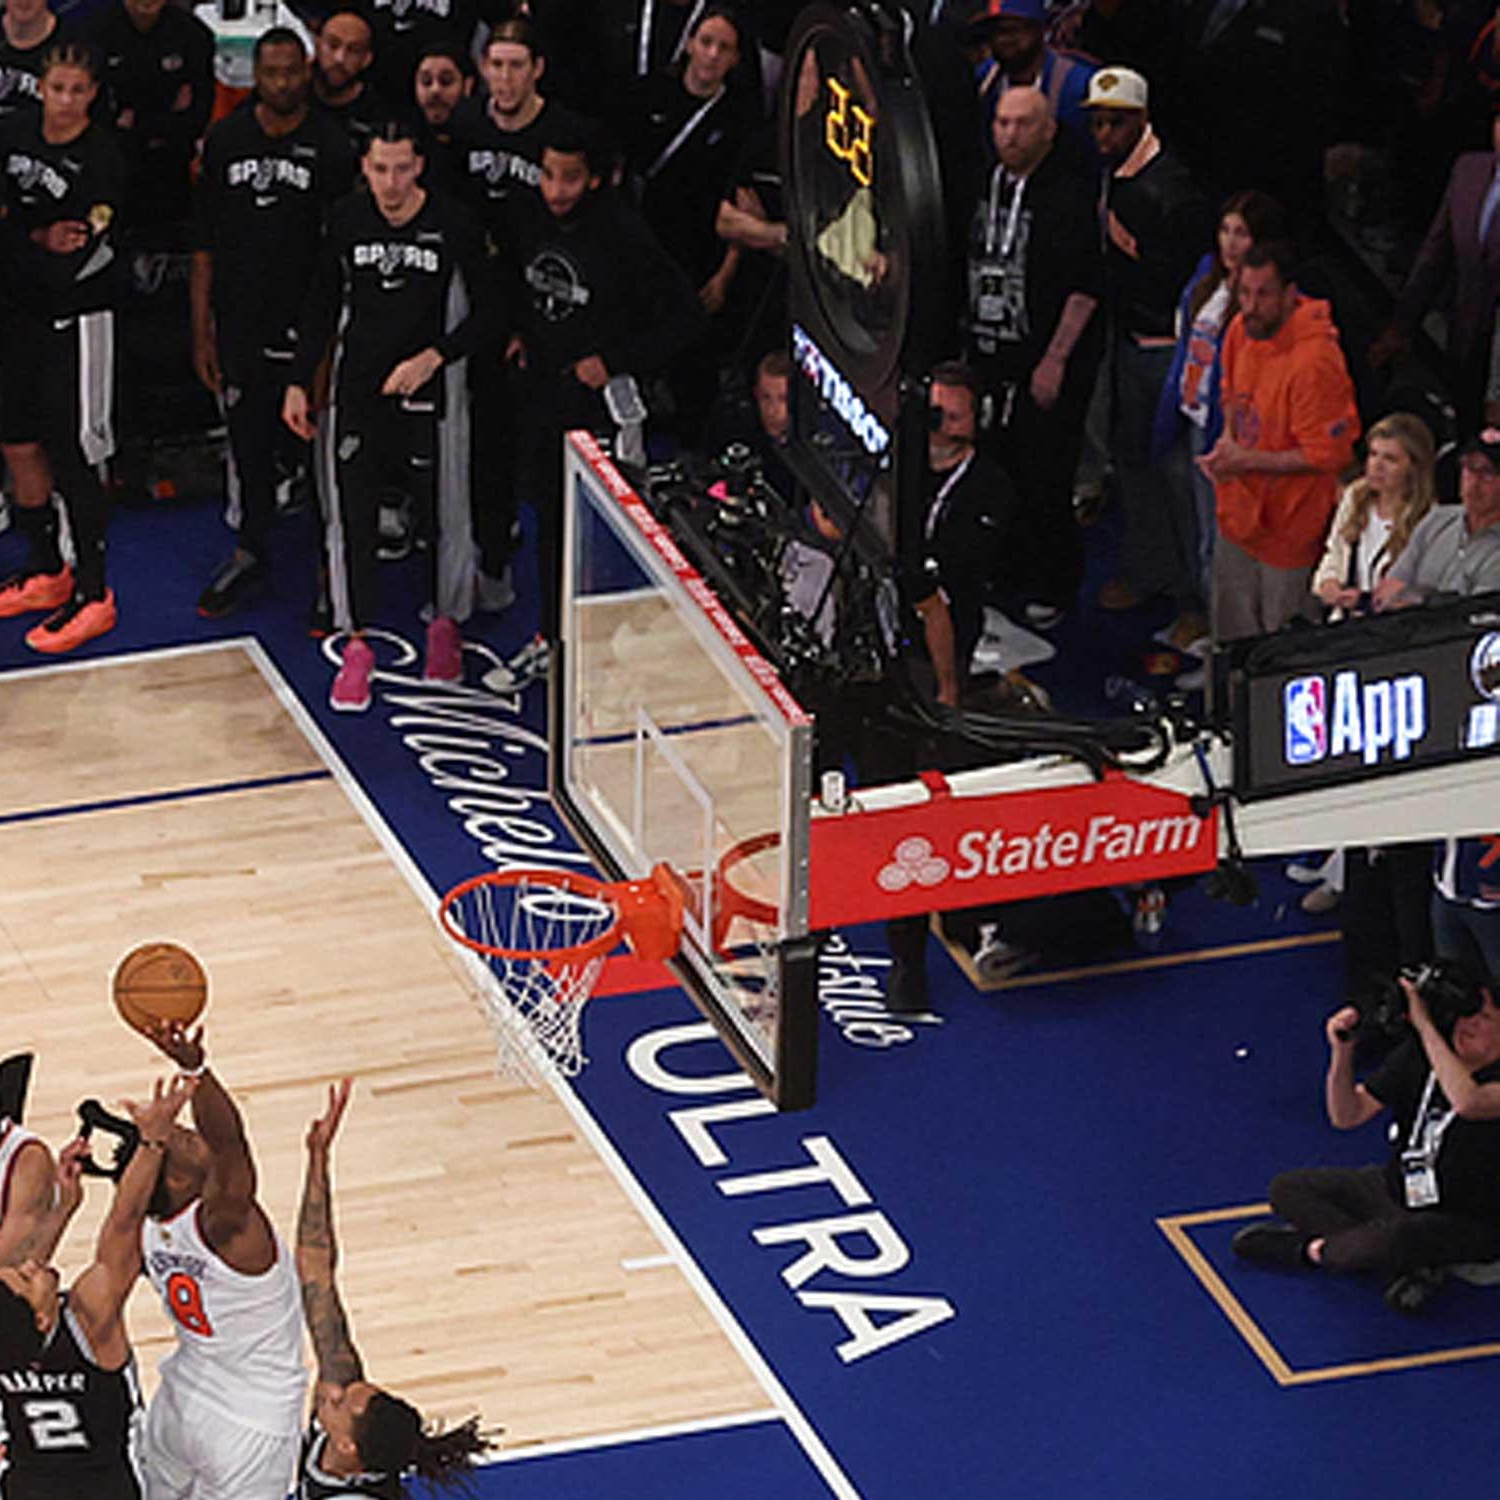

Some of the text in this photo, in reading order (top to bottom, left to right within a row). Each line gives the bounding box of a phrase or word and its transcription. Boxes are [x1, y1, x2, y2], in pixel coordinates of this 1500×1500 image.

[1331, 671, 1426, 765] App
[626, 1022, 956, 1364] ULTRA
[166, 1272, 214, 1338] 8
[23, 1401, 90, 1450] 2
